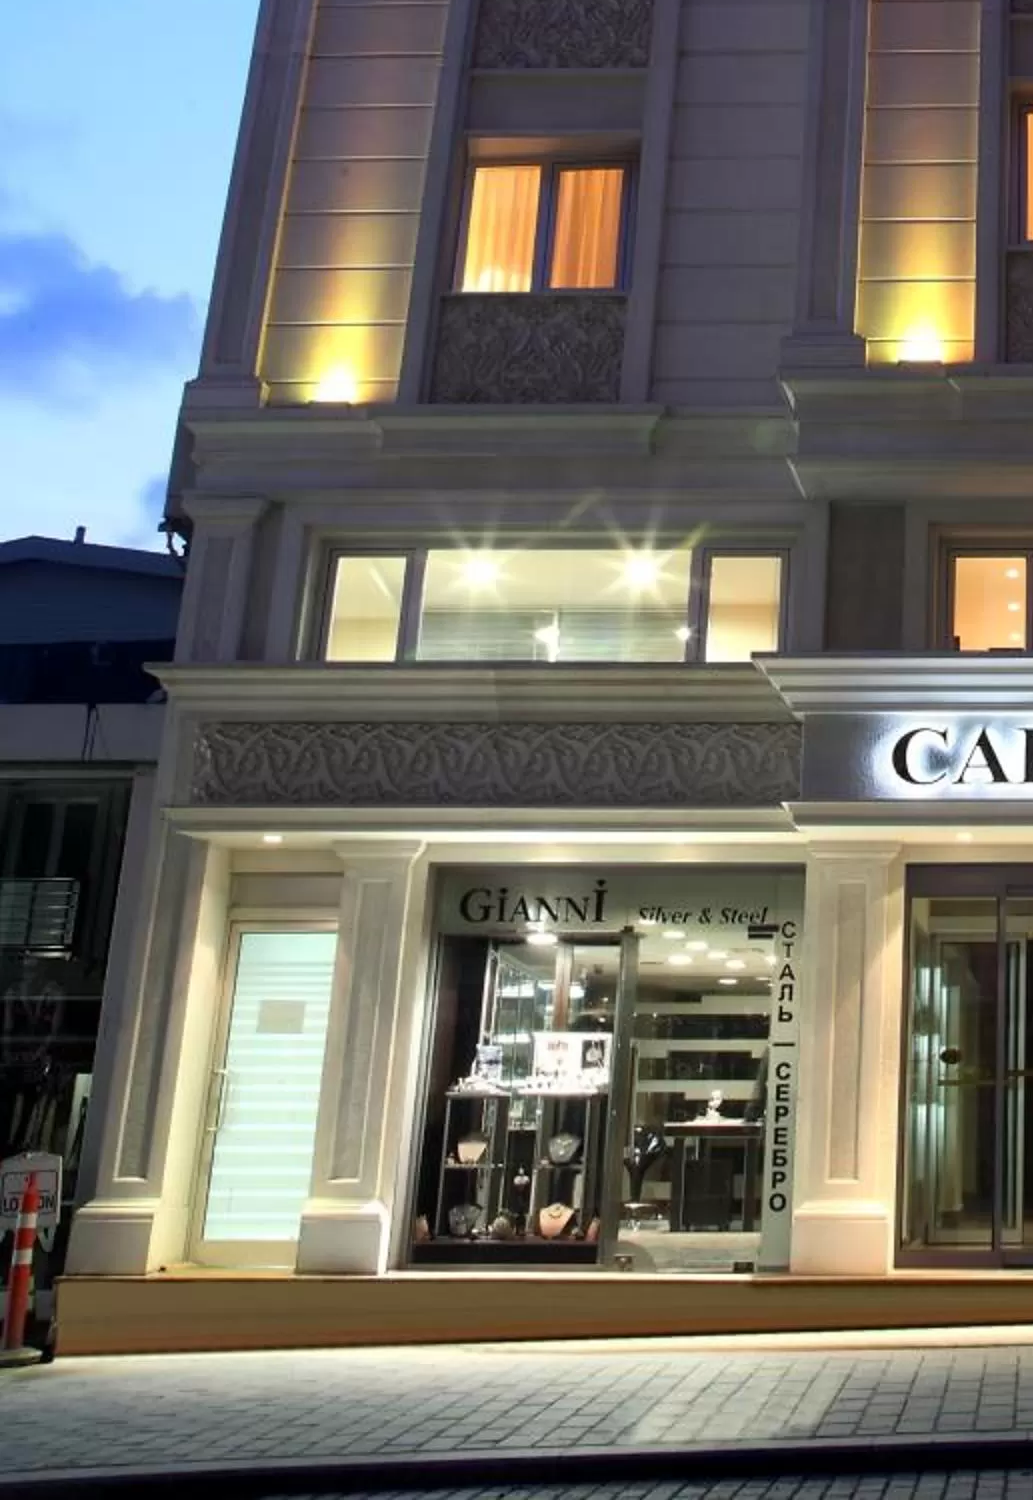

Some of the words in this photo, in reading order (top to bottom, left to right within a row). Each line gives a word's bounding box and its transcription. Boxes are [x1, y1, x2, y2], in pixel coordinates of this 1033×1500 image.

[638, 906, 692, 925] Silver
[697, 907, 712, 925] &
[719, 907, 768, 925] Steel
[778, 921, 797, 1023] СТАЛЬ
[769, 1062, 792, 1213] СЕРЕБРО
